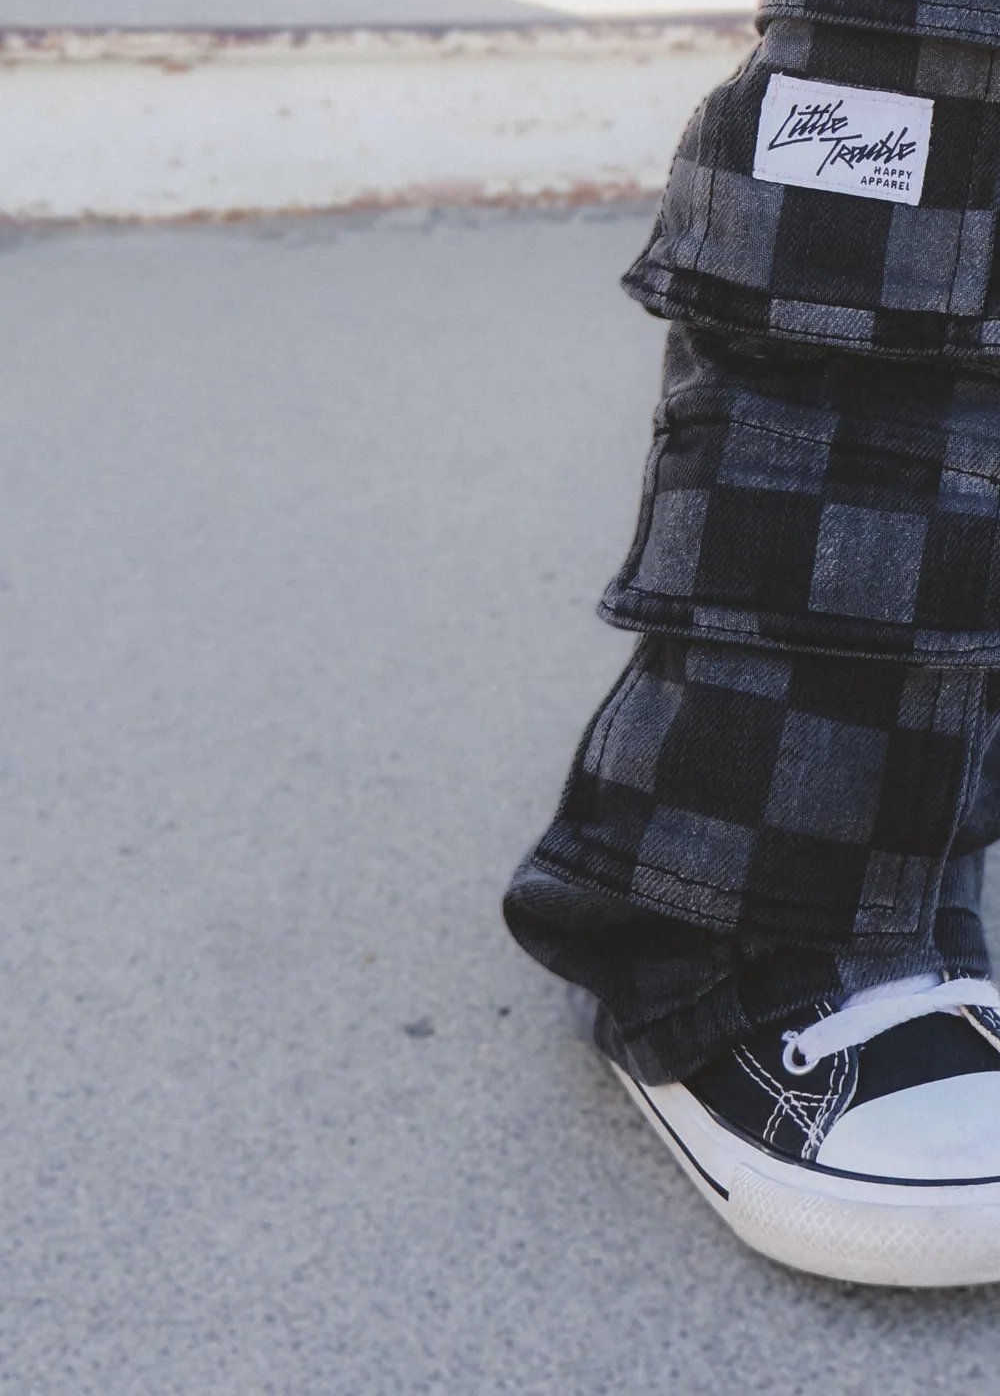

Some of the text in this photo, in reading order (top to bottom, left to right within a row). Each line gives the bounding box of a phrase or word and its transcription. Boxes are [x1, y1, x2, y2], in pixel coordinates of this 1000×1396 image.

[768, 100, 849, 151] Little
[873, 166, 913, 179] HAPPY
[860, 176, 911, 192] APPAREL
